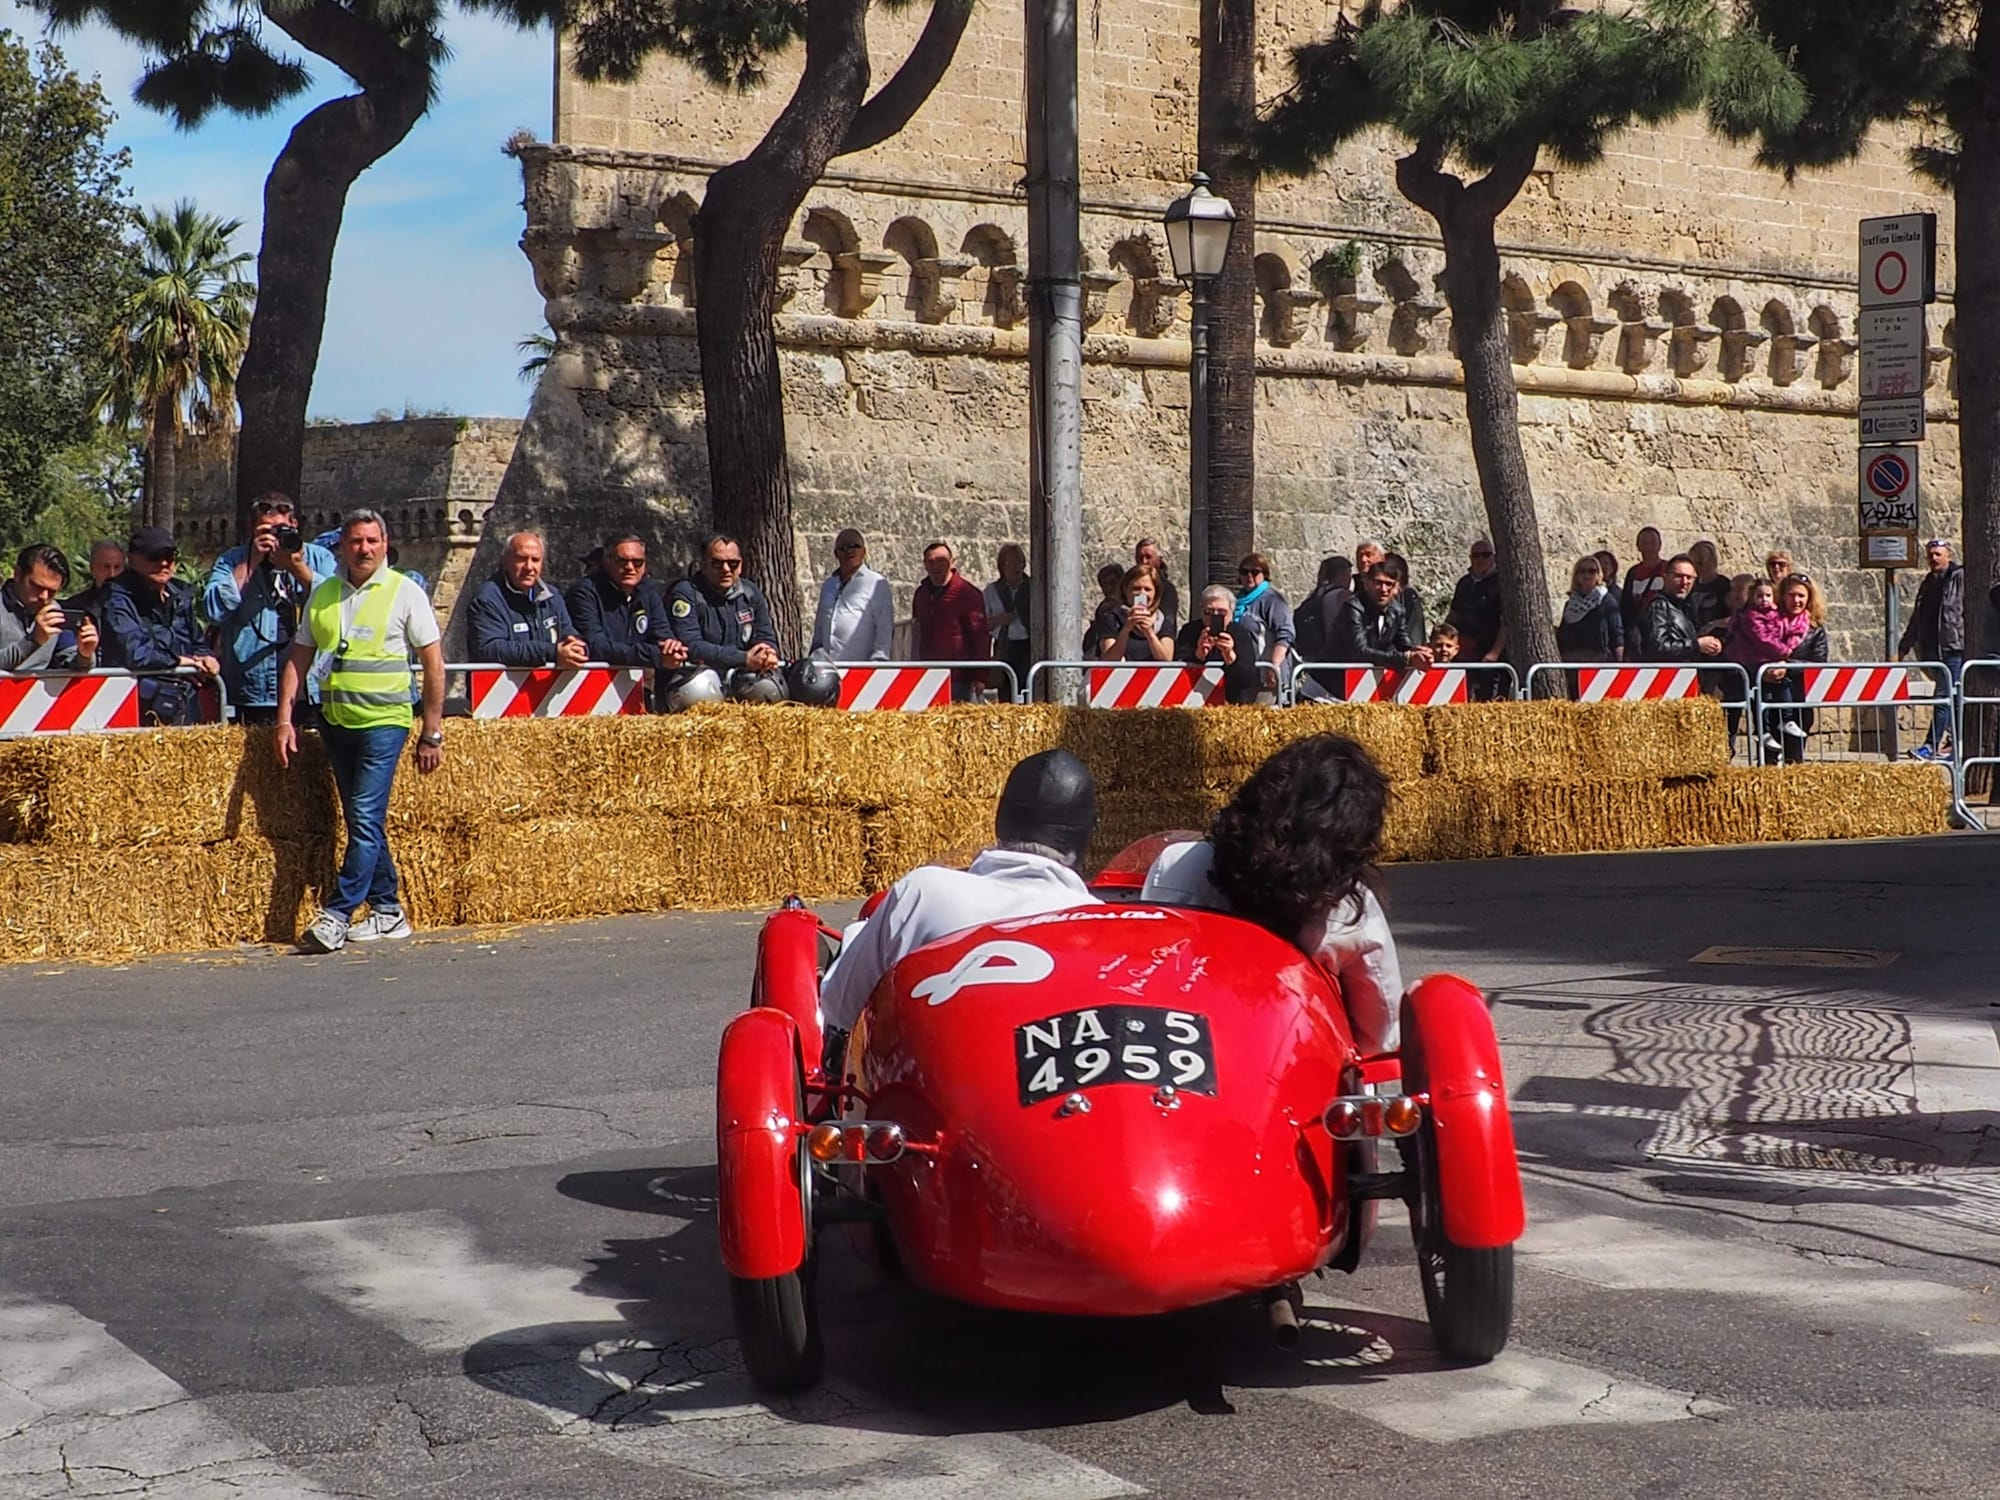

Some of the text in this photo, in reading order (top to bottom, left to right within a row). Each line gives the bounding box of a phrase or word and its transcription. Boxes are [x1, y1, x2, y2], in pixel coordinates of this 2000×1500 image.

[1910, 419, 1918, 433] 3
[1023, 1010, 1200, 1058] NA 5
[1028, 1046, 1206, 1092] 4959
